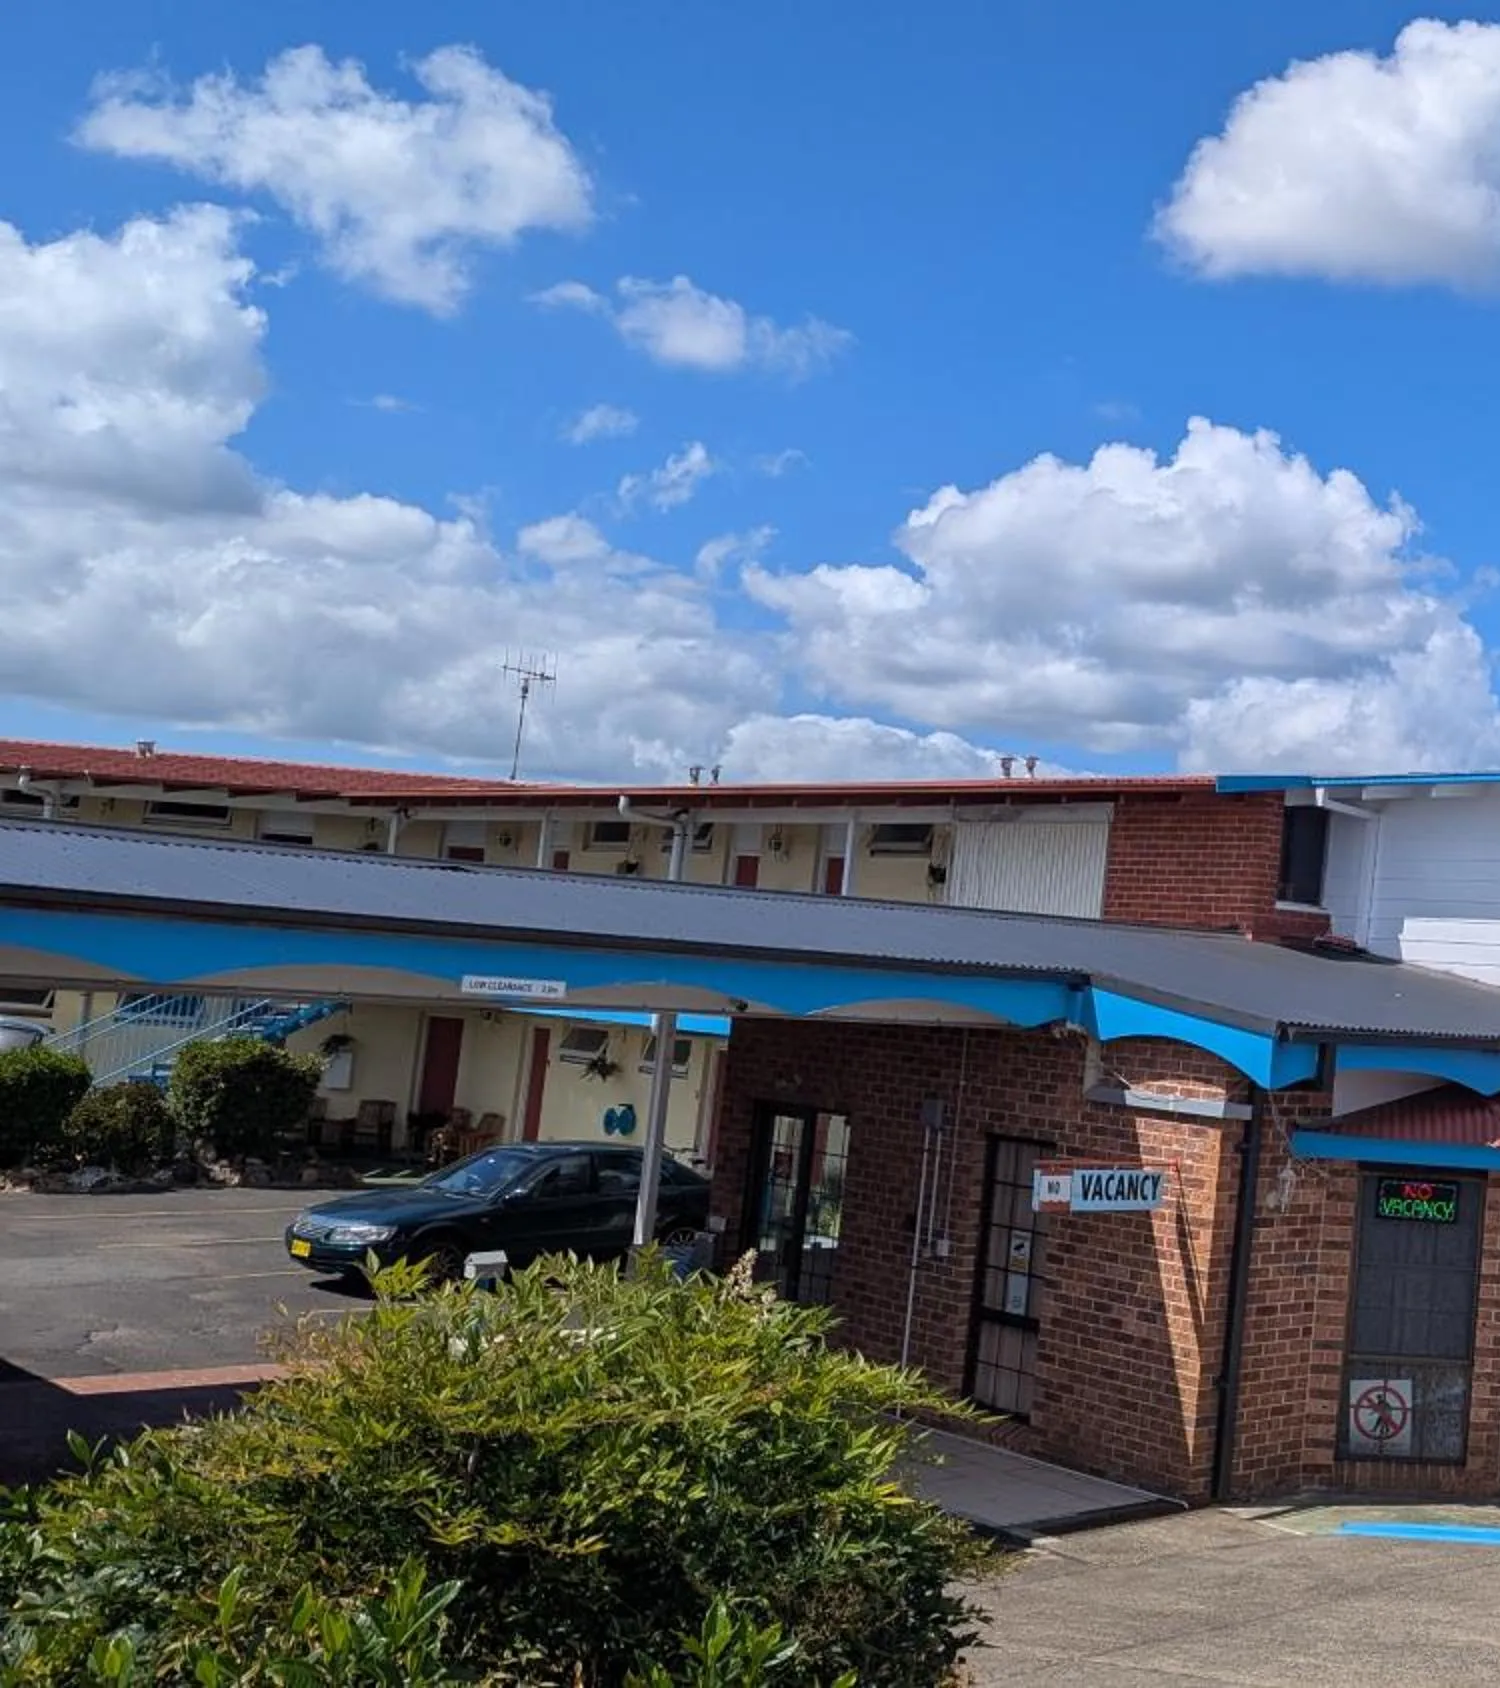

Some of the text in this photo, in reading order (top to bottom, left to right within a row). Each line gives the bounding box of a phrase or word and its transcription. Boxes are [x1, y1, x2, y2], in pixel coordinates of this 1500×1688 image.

[1081, 1173, 1161, 1201] VACANCY
[1402, 1184, 1433, 1200] NO
[1382, 1198, 1455, 1220] VACANCY
